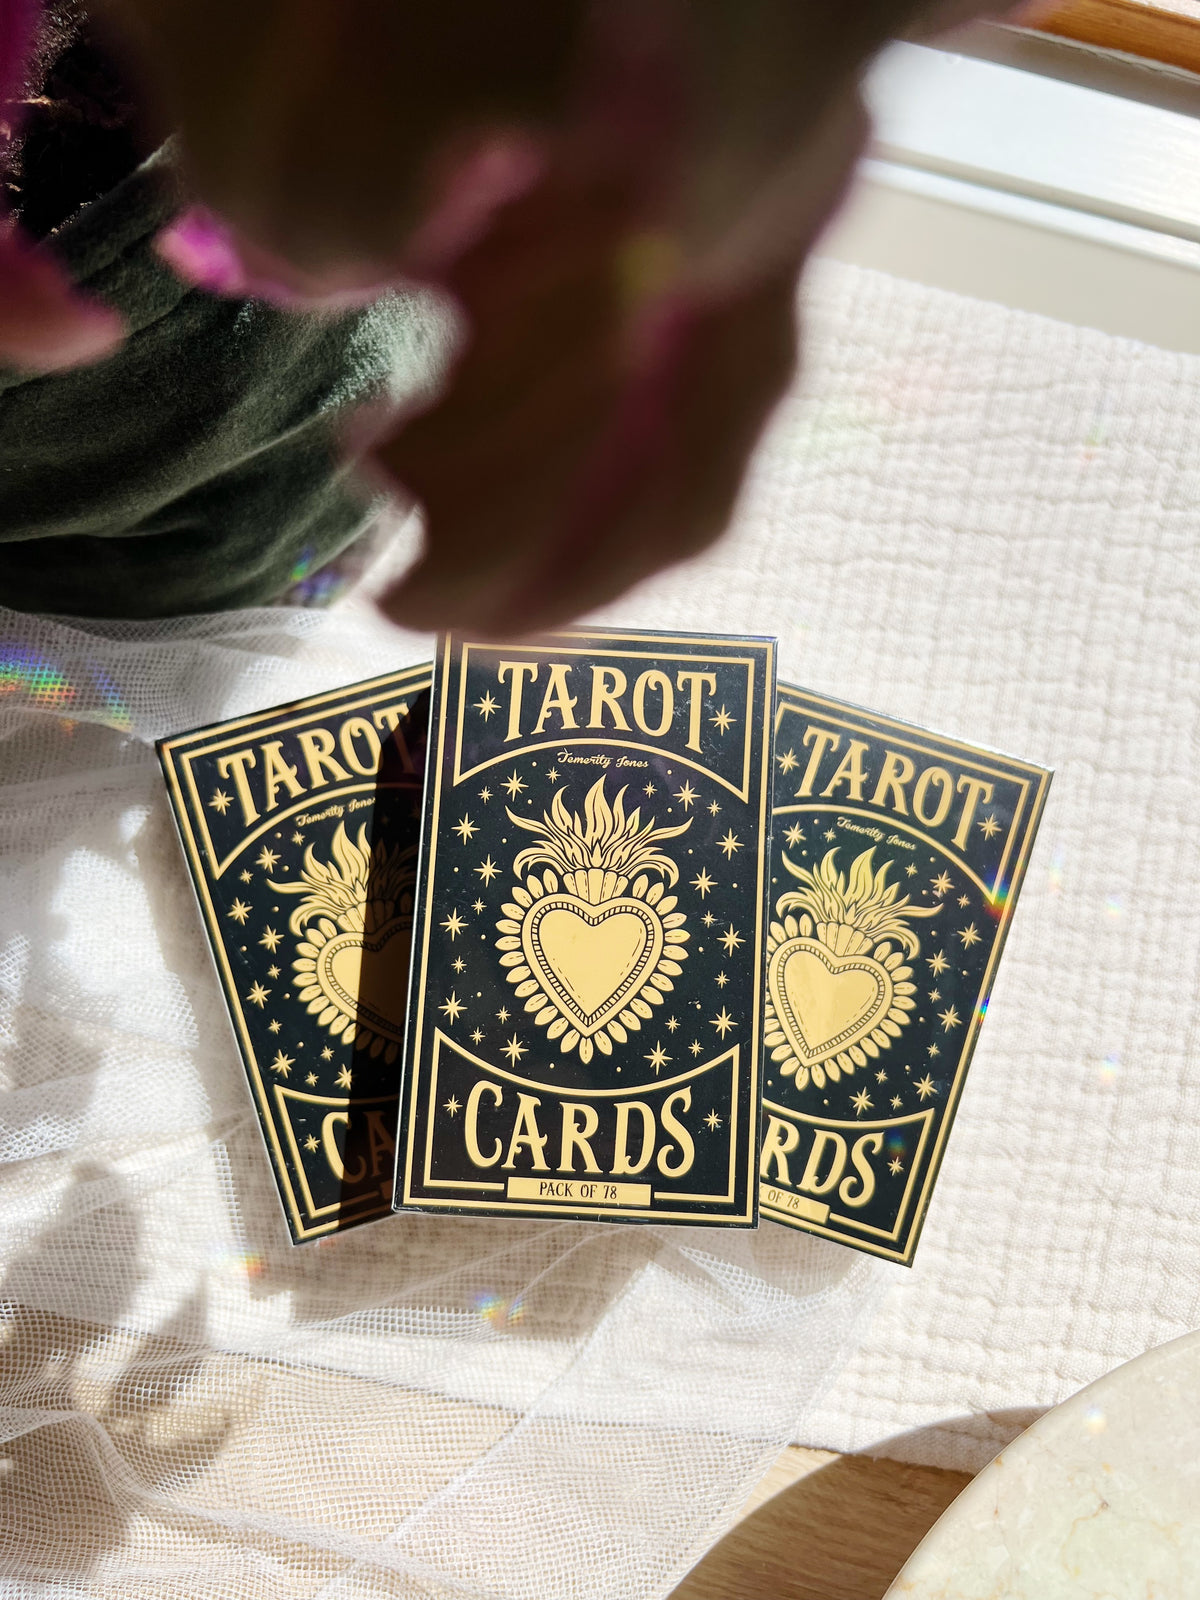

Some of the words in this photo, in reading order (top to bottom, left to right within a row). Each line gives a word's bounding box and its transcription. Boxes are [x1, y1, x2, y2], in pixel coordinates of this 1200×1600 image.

[498, 660, 717, 754] TAROT
[217, 702, 417, 827] TAROT
[557, 752, 613, 769] Temerity
[615, 755, 649, 768] Jones
[794, 725, 994, 851] TAROT
[464, 1080, 695, 1178] CARDS
[760, 1115, 884, 1207] RDS
[540, 1181, 573, 1197] PACK
[580, 1184, 598, 1198] OF
[603, 1185, 617, 1199] 78
[768, 1189, 784, 1203] OF
[787, 1194, 800, 1210] 78
